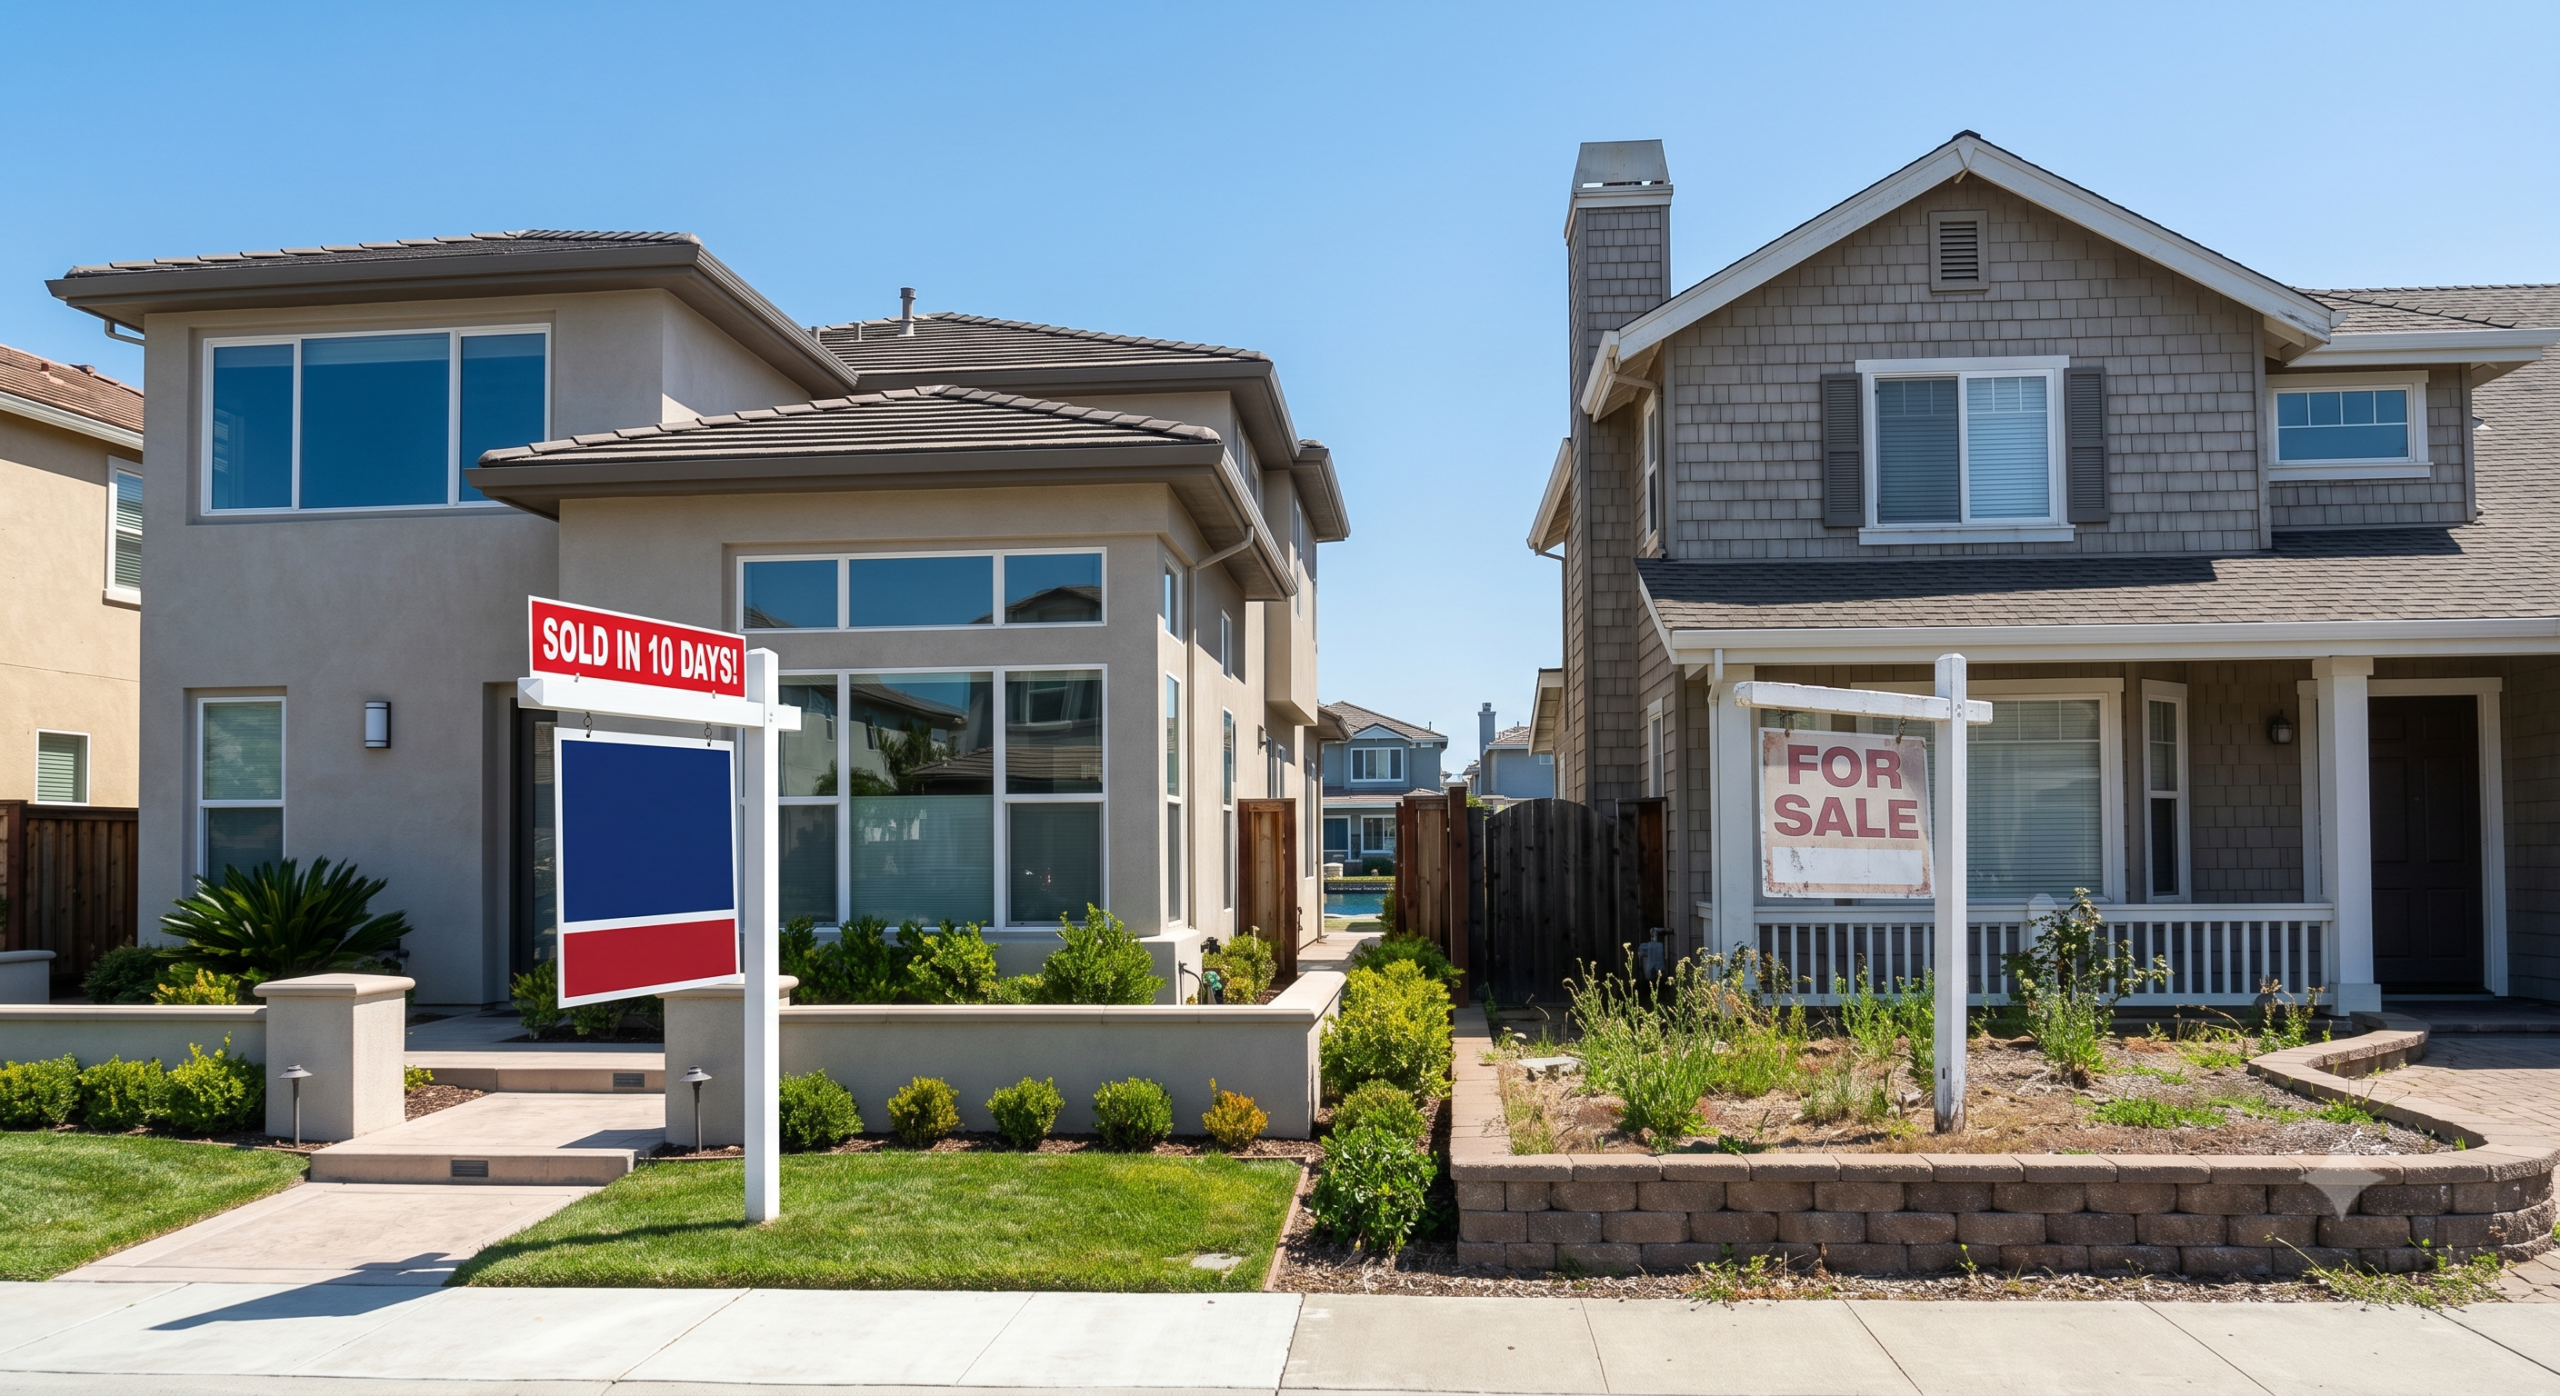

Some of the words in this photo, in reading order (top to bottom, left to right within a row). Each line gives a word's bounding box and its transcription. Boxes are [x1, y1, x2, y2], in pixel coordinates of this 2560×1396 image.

[542, 616, 609, 667] SOLD
[616, 628, 641, 672] IN
[648, 633, 673, 677] 10
[680, 639, 739, 685] DAYS!
[1786, 744, 1902, 790] FOR
[1773, 794, 1919, 840] SALE
